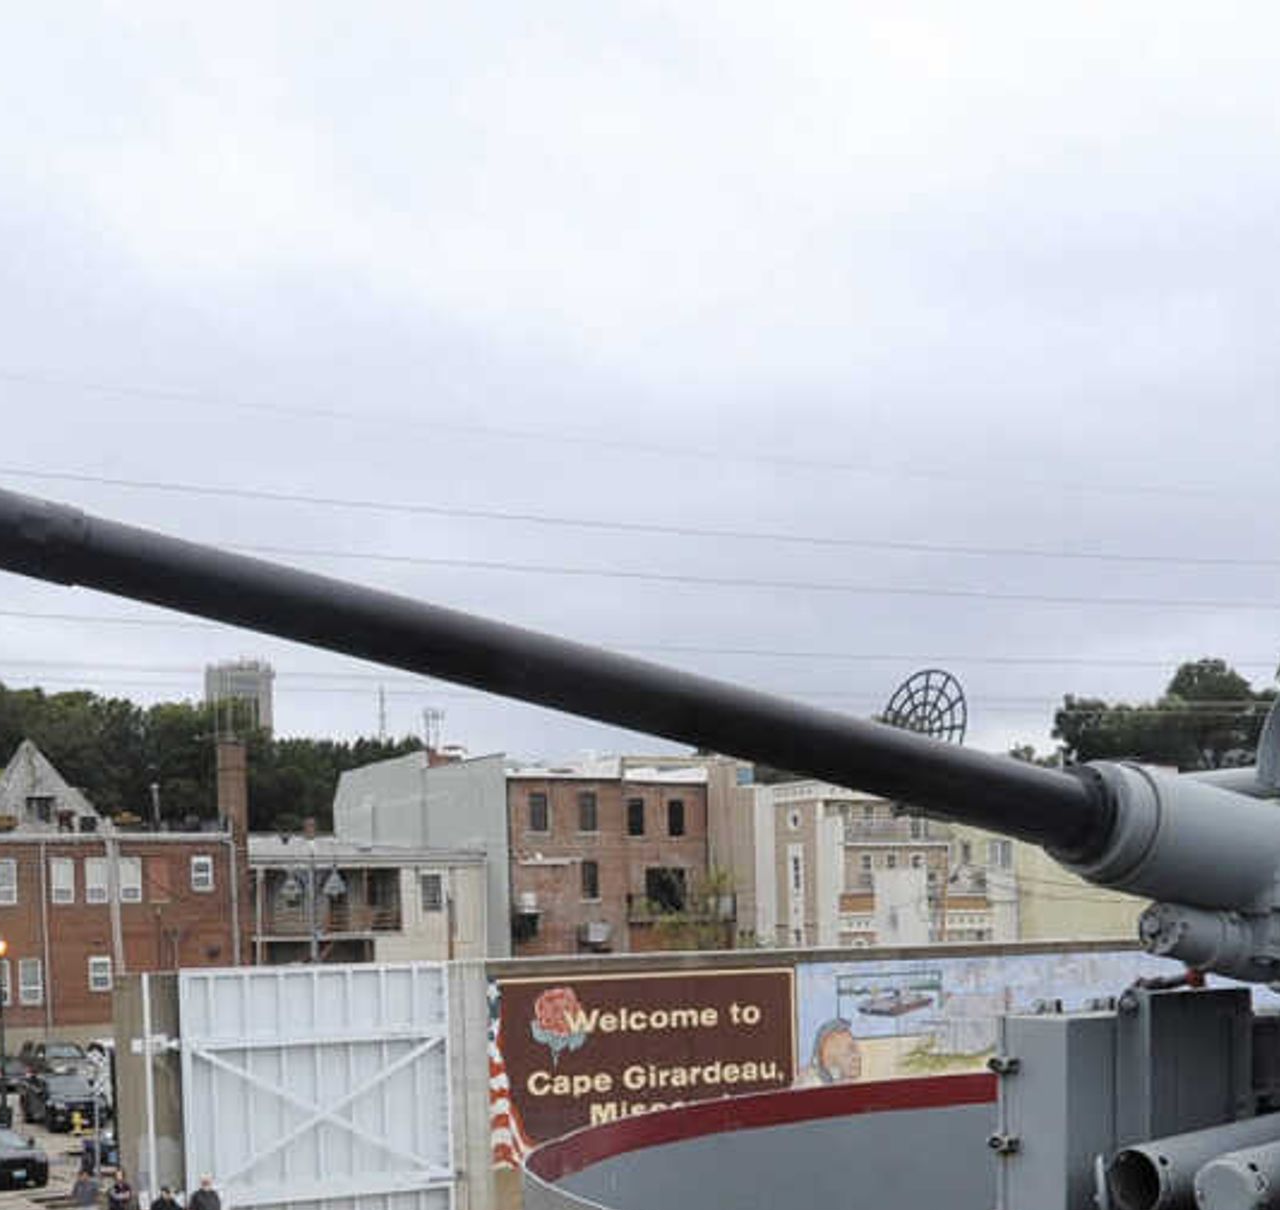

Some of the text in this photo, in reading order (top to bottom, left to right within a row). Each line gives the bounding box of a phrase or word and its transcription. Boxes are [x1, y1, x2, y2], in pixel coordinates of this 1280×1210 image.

[564, 1002, 761, 1034] Welcome to
[527, 1060, 785, 1098] Cape Girardeau,
